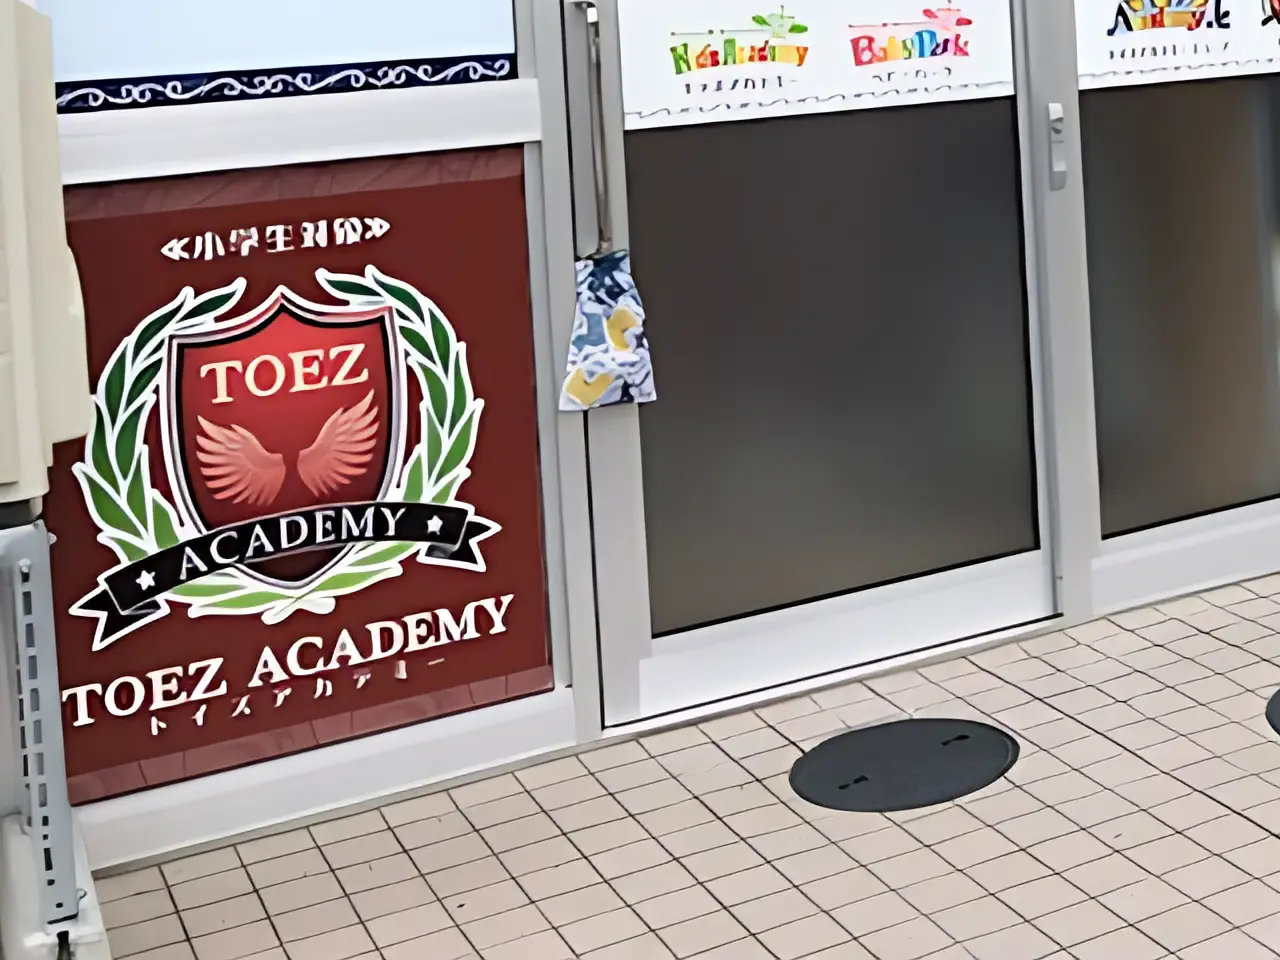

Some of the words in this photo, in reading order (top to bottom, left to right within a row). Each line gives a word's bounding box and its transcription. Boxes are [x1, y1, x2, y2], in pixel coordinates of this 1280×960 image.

[200, 343, 370, 405] TOEZ
[178, 506, 409, 581] ACADEMY
[61, 656, 228, 728] TOEZ
[248, 593, 516, 688] ACADEMY
